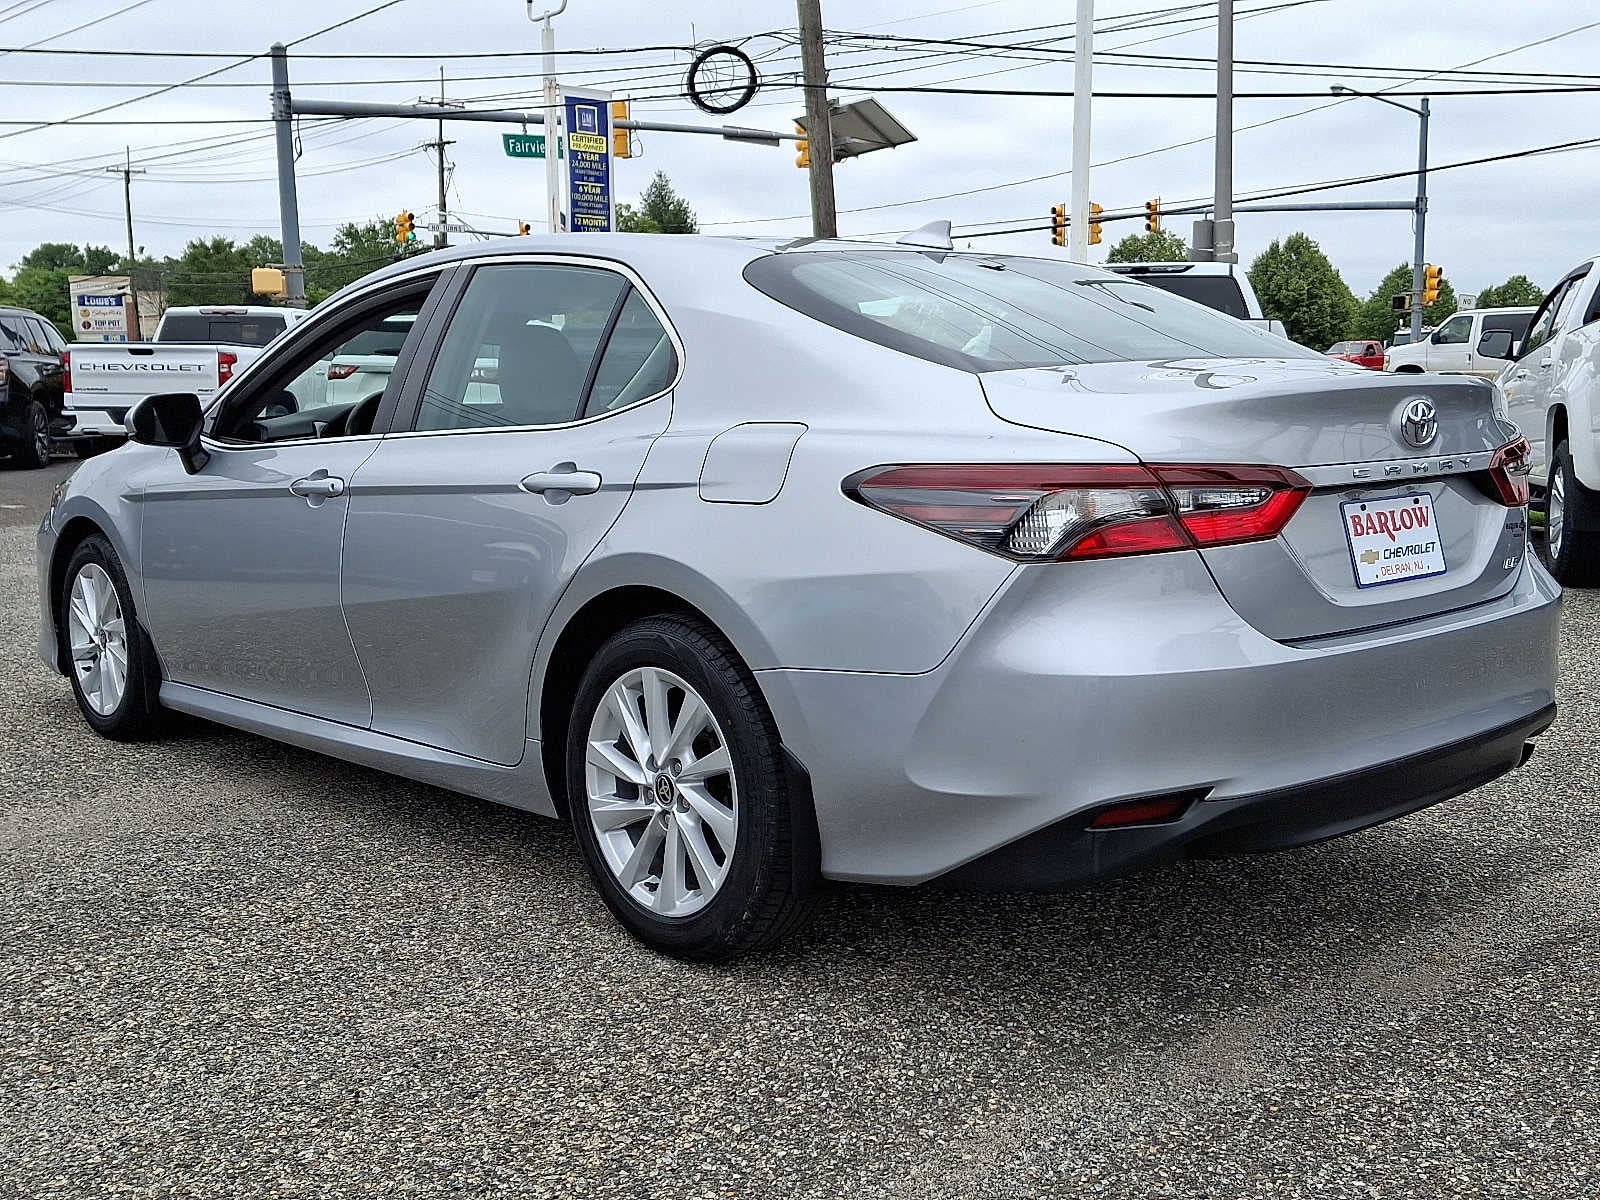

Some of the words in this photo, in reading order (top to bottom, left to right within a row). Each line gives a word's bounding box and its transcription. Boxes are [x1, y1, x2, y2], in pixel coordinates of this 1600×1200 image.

[571, 134, 604, 145] CERTIFIED
[509, 139, 545, 153] Fairvie
[572, 143, 604, 152] PRE-OWNED
[583, 153, 599, 161] YEAR
[571, 160, 591, 169] 24,000
[592, 162, 607, 171] MILE
[584, 186, 601, 194] YEAR
[572, 192, 593, 201] 100,000
[594, 195, 608, 203] MILE
[574, 217, 582, 225] 12
[583, 218, 608, 227] MONTH
[93, 319, 107, 327] TOP
[79, 363, 205, 372] CHEVROLET
[1352, 457, 1471, 478] CAMRY
[1350, 506, 1429, 542] BARLOW
[1383, 541, 1437, 560] CHEVROLET
[1414, 560, 1424, 570] NJ
